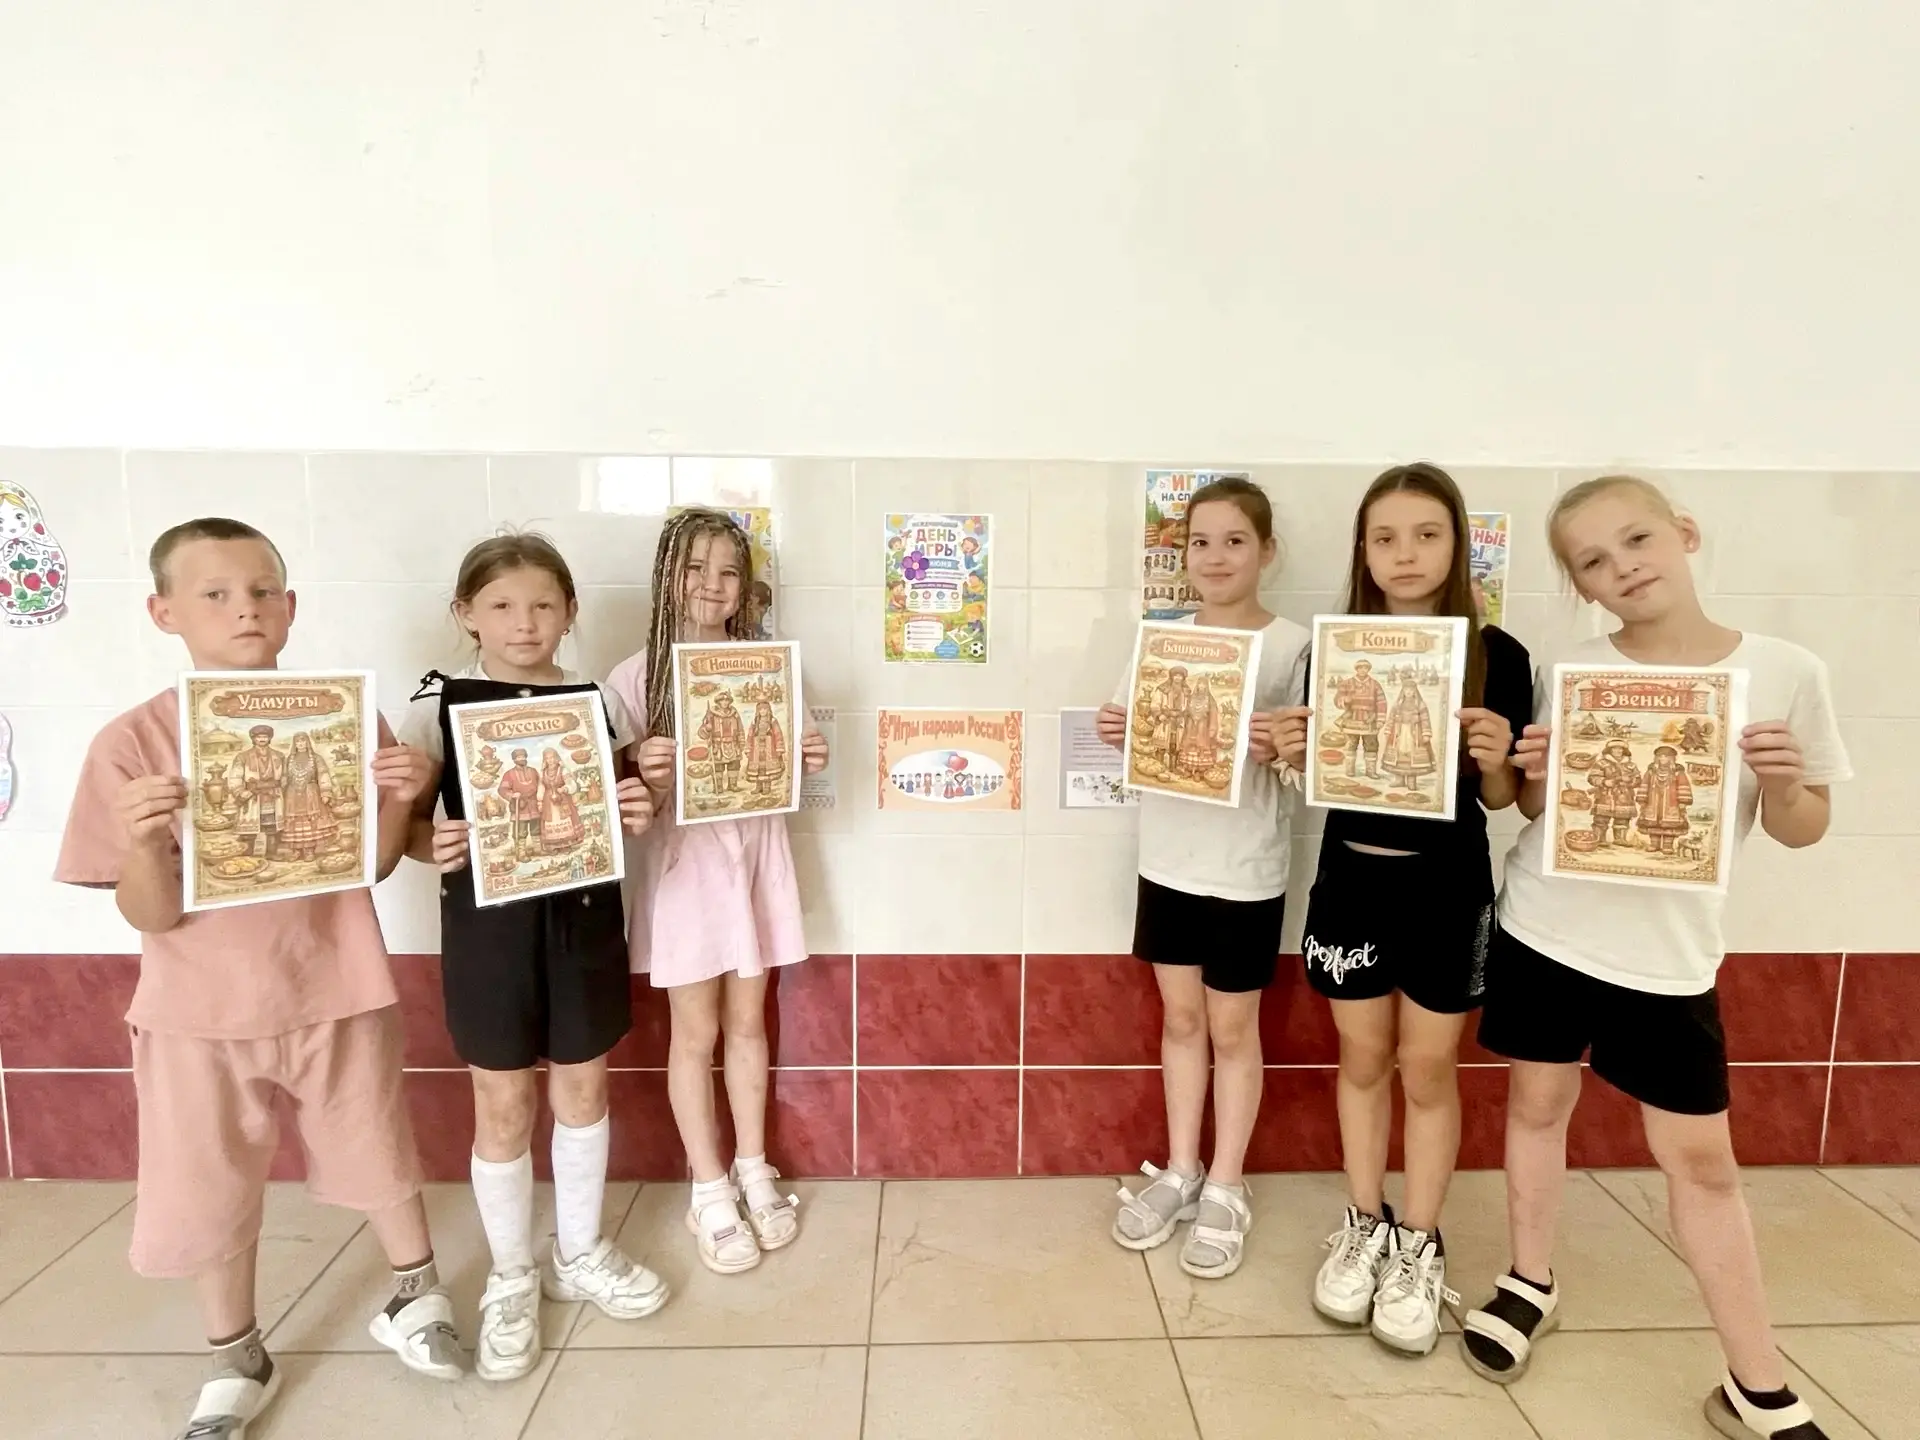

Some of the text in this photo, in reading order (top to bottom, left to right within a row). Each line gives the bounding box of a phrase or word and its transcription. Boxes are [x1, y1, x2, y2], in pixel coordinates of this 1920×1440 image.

[1172, 473, 1214, 491] ИГР
[1161, 493, 1191, 501] НА СП
[915, 528, 957, 543] ДЕНЬ
[914, 543, 958, 557] ИГРЫ
[1361, 632, 1408, 647] Коми
[1162, 639, 1221, 658] Башкиры
[237, 694, 318, 710] Удмурты
[1600, 690, 1680, 708] Эвенки
[495, 718, 561, 737] Русские
[922, 719, 965, 739] народов
